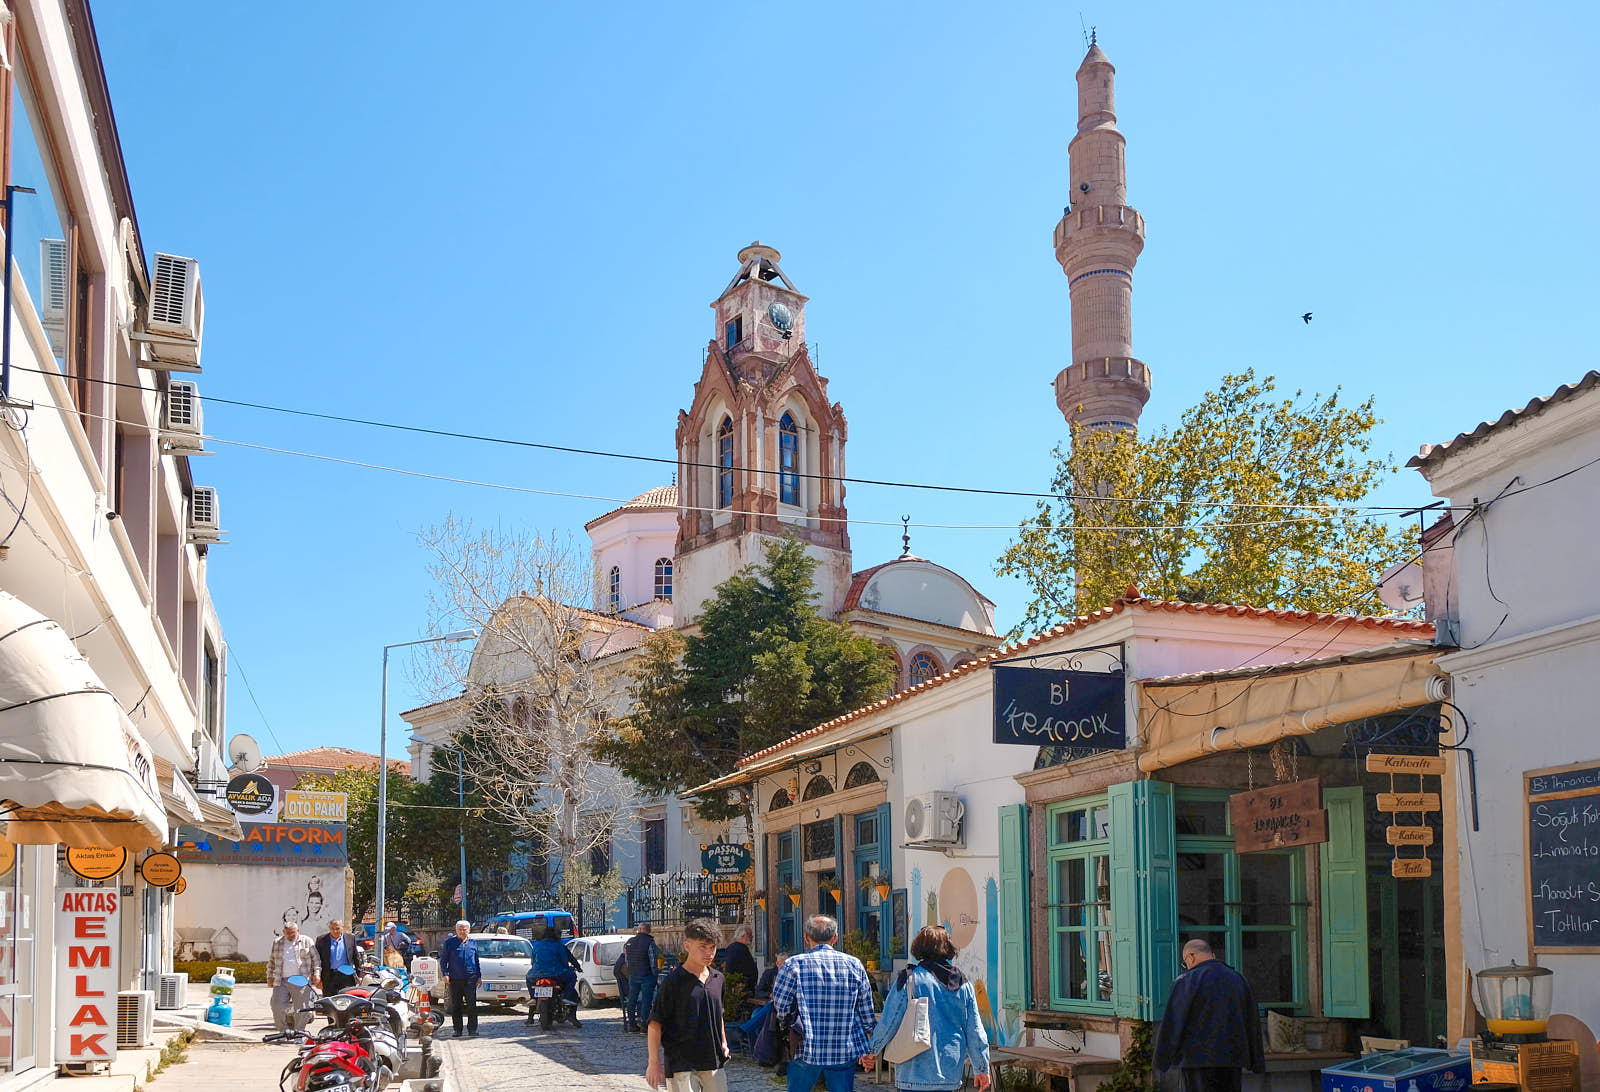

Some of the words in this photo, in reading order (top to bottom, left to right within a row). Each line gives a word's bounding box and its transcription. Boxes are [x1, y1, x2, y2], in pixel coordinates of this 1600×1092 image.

[1050, 679, 1070, 705] Bİ
[1002, 698, 1121, 742] İKRAMCIK
[228, 793, 255, 802] AYVALIK
[257, 795, 272, 803] ADA
[288, 800, 311, 816] OTO
[314, 801, 344, 818] PARK
[218, 825, 343, 845] ATFORM
[232, 842, 322, 853] EMLAK
[62, 892, 118, 915] AKTAŞ
[68, 916, 111, 1056] EMLAK
